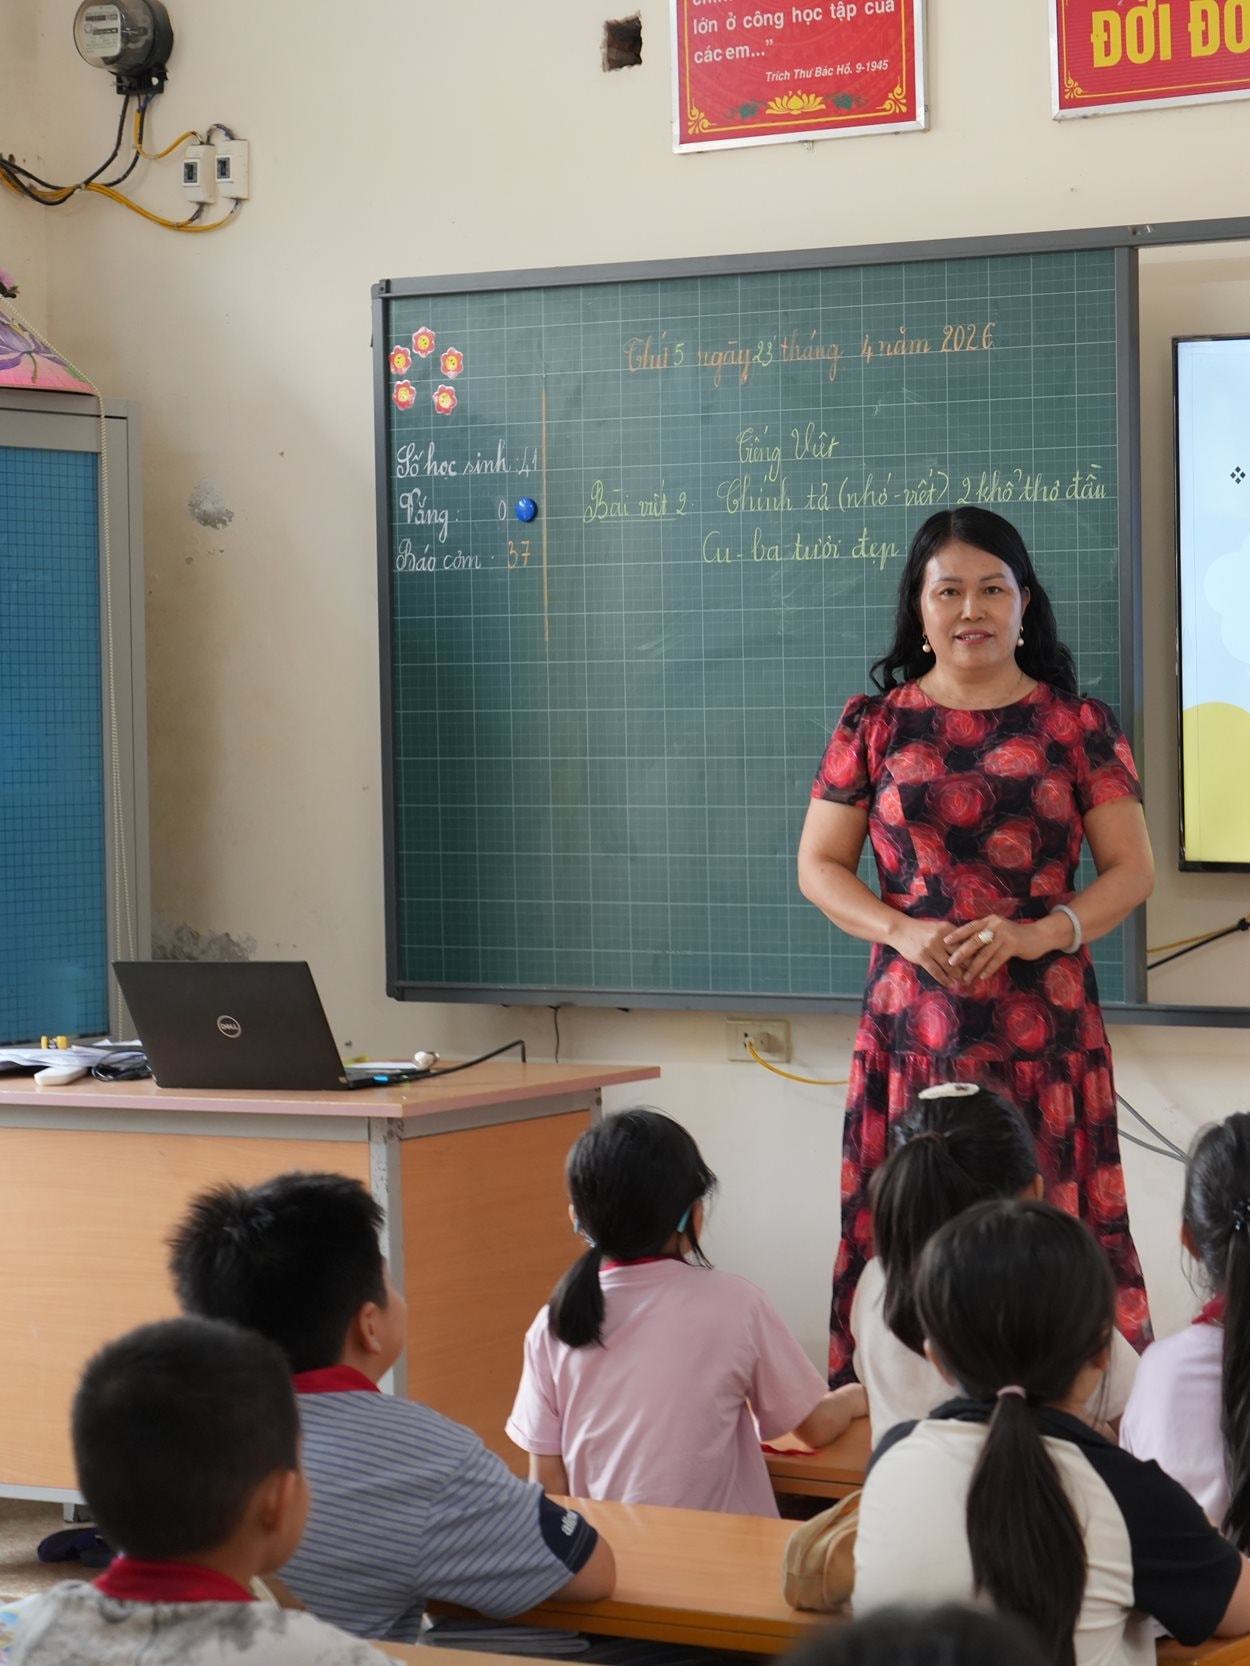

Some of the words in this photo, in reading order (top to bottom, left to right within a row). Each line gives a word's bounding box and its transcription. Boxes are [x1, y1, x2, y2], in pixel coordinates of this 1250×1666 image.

[693, 17, 718, 34] lớn
[726, 12, 737, 31] ở
[743, 10, 784, 29] công
[792, 6, 823, 25] học
[830, 1, 857, 22] tập
[694, 45, 722, 64] các
[765, 71, 790, 83] Trích
[793, 67, 813, 80] Thư
[815, 66, 833, 78] Bác
[856, 59, 889, 74] 9-1945
[673, 342, 685, 367] 5
[696, 337, 750, 388] ngày
[752, 336, 777, 368] 23
[780, 329, 844, 382] tháng
[860, 334, 872, 364] 4
[878, 326, 931, 357] năm
[940, 322, 997, 353] 2026
[396, 442, 424, 479] Số
[424, 441, 457, 480] học
[463, 439, 511, 476] sinh
[736, 425, 782, 483] Tiếng
[497, 499, 507, 521] 0
[583, 479, 629, 524] Bài
[716, 472, 793, 514] Chính
[804, 482, 831, 512] tả
[957, 477, 971, 504] 2
[977, 468, 1022, 504] khổ
[1019, 473, 1061, 502] thơ
[1065, 463, 1107, 501] đầu
[396, 538, 436, 572] Báo
[442, 550, 482, 570] cơm
[507, 540, 531, 569] 37
[851, 527, 900, 571] đẹp
